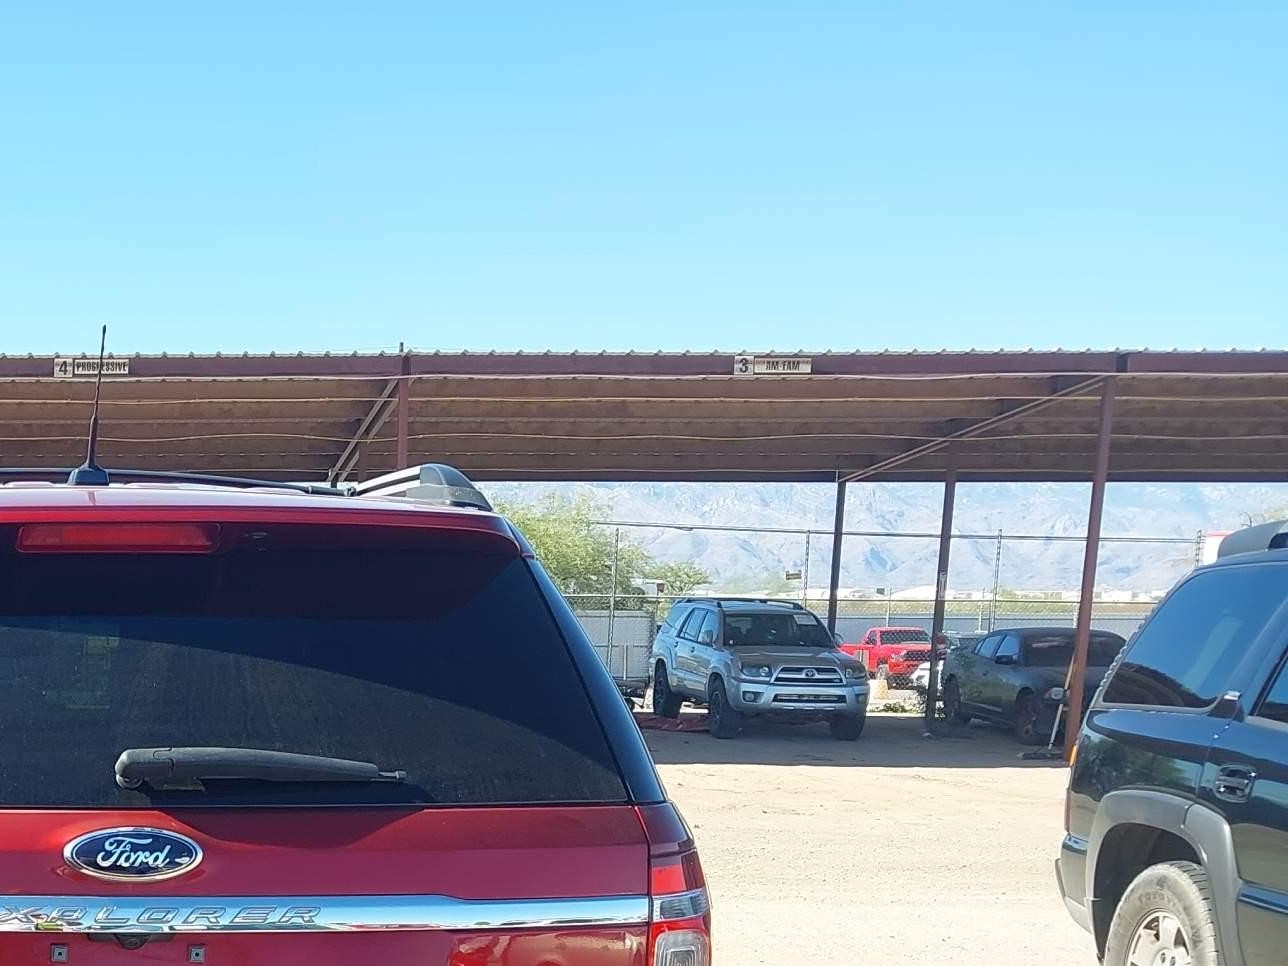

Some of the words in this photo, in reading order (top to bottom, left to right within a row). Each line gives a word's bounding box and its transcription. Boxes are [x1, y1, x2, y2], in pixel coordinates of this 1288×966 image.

[58, 360, 69, 376] 4
[739, 358, 750, 373] 3
[96, 836, 172, 867] Ford
